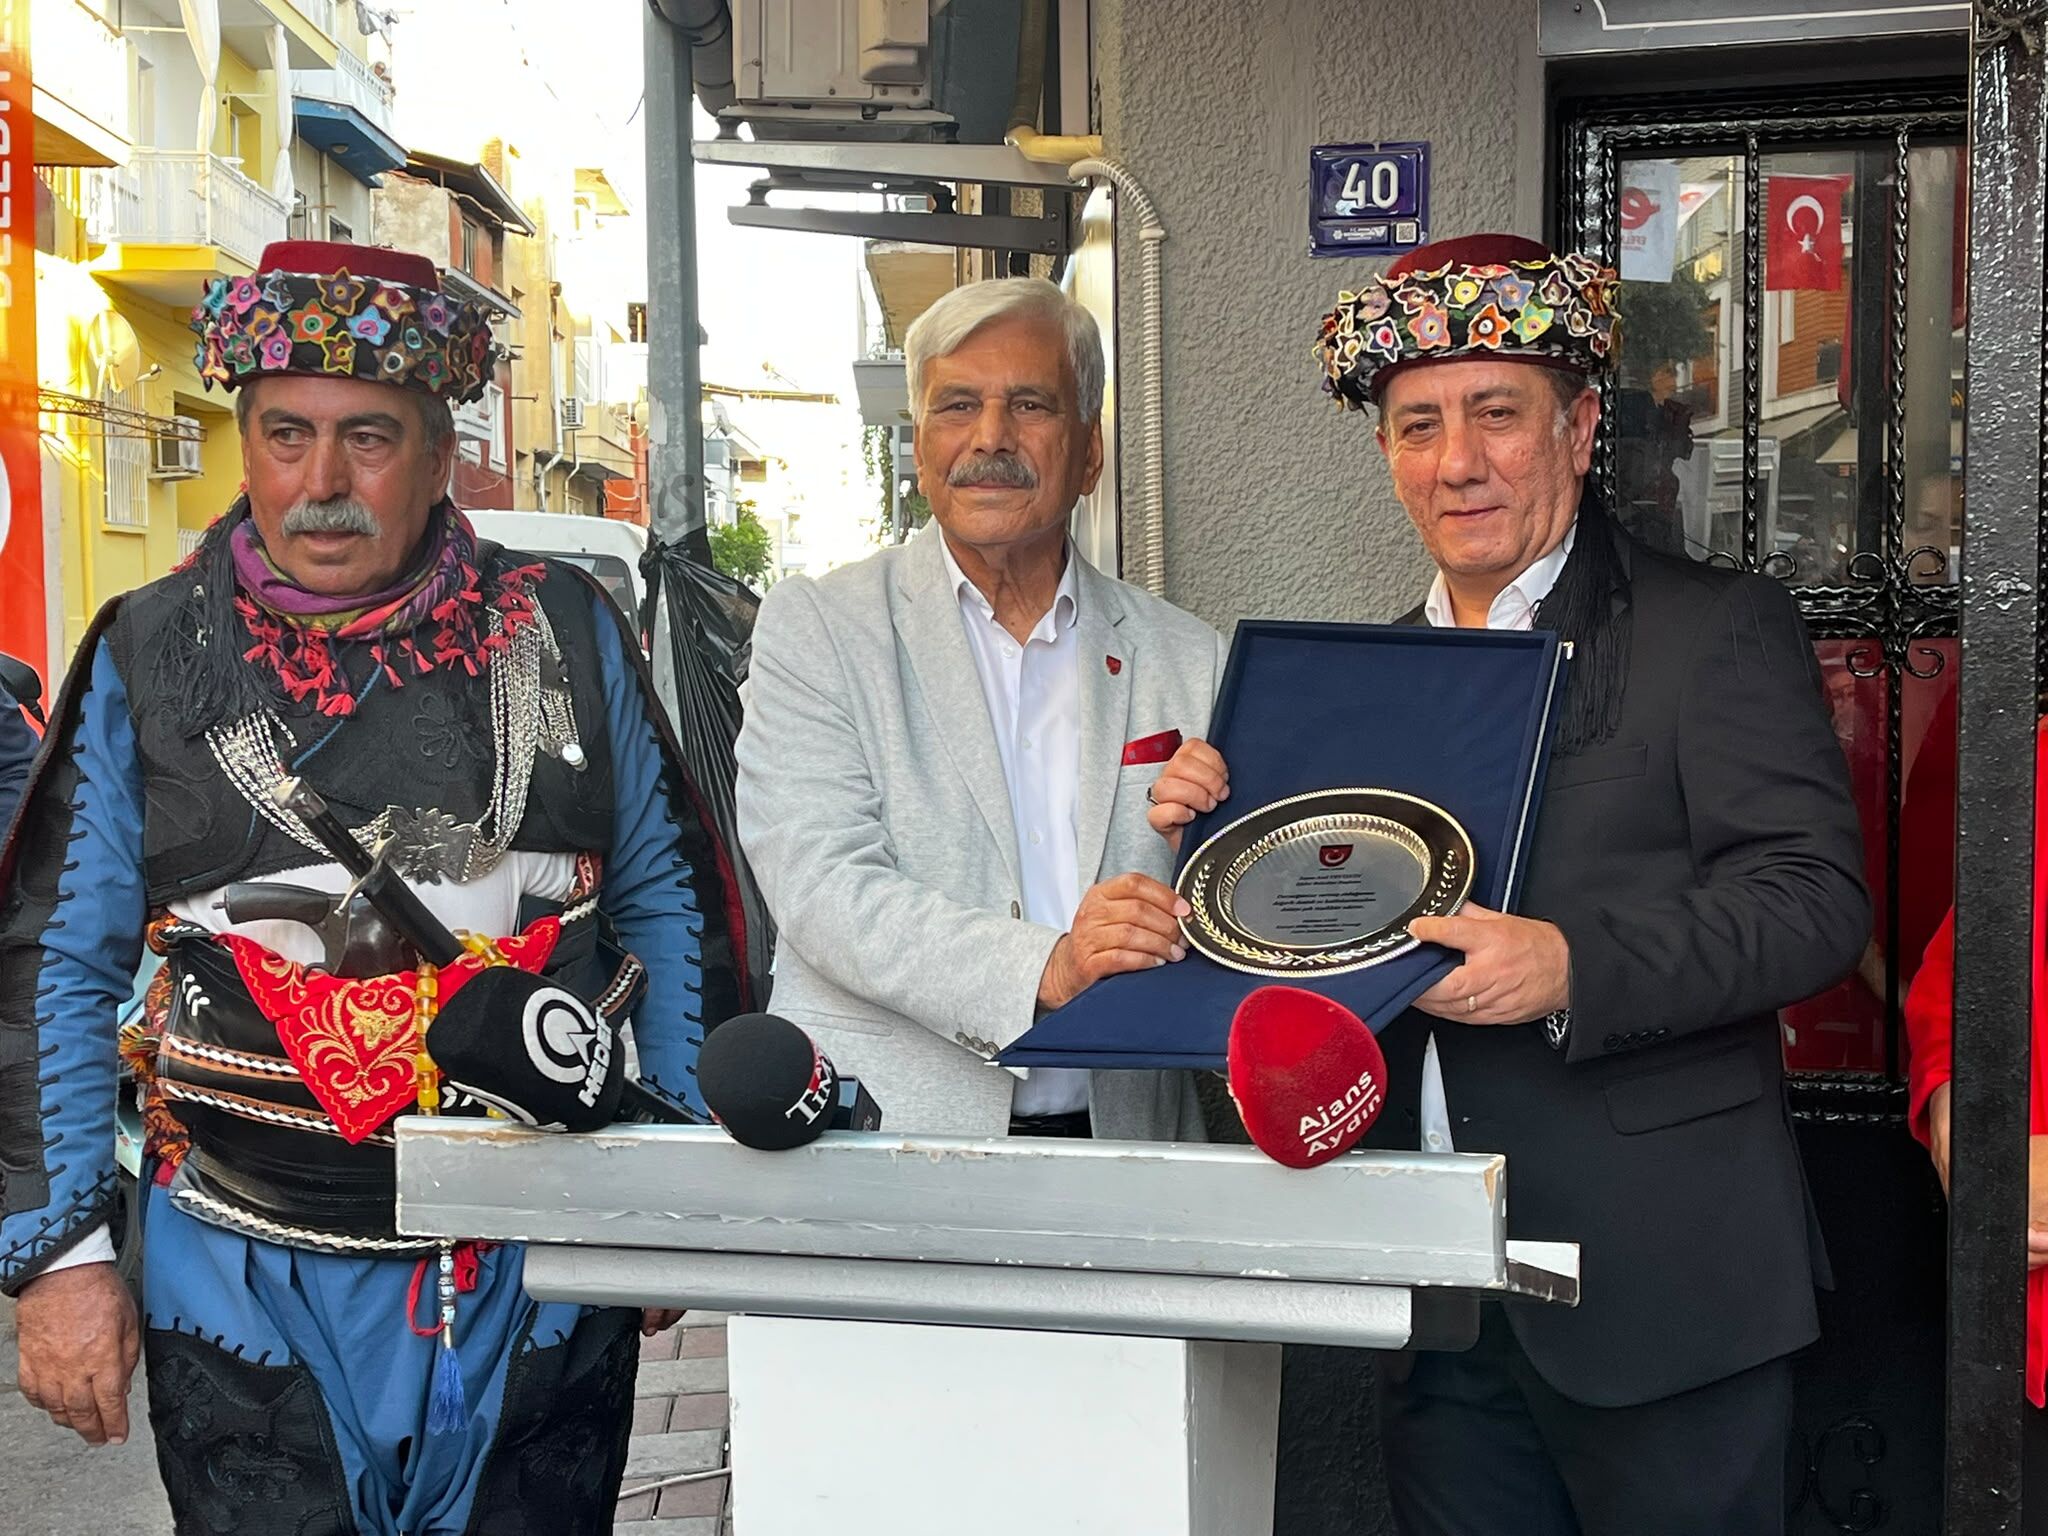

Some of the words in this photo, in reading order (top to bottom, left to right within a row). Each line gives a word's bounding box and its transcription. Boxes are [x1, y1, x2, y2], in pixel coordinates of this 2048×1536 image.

[1341, 160, 1399, 209] 40
[1298, 1070, 1373, 1136] Ajans
[1306, 1093, 1382, 1158] Aydın
